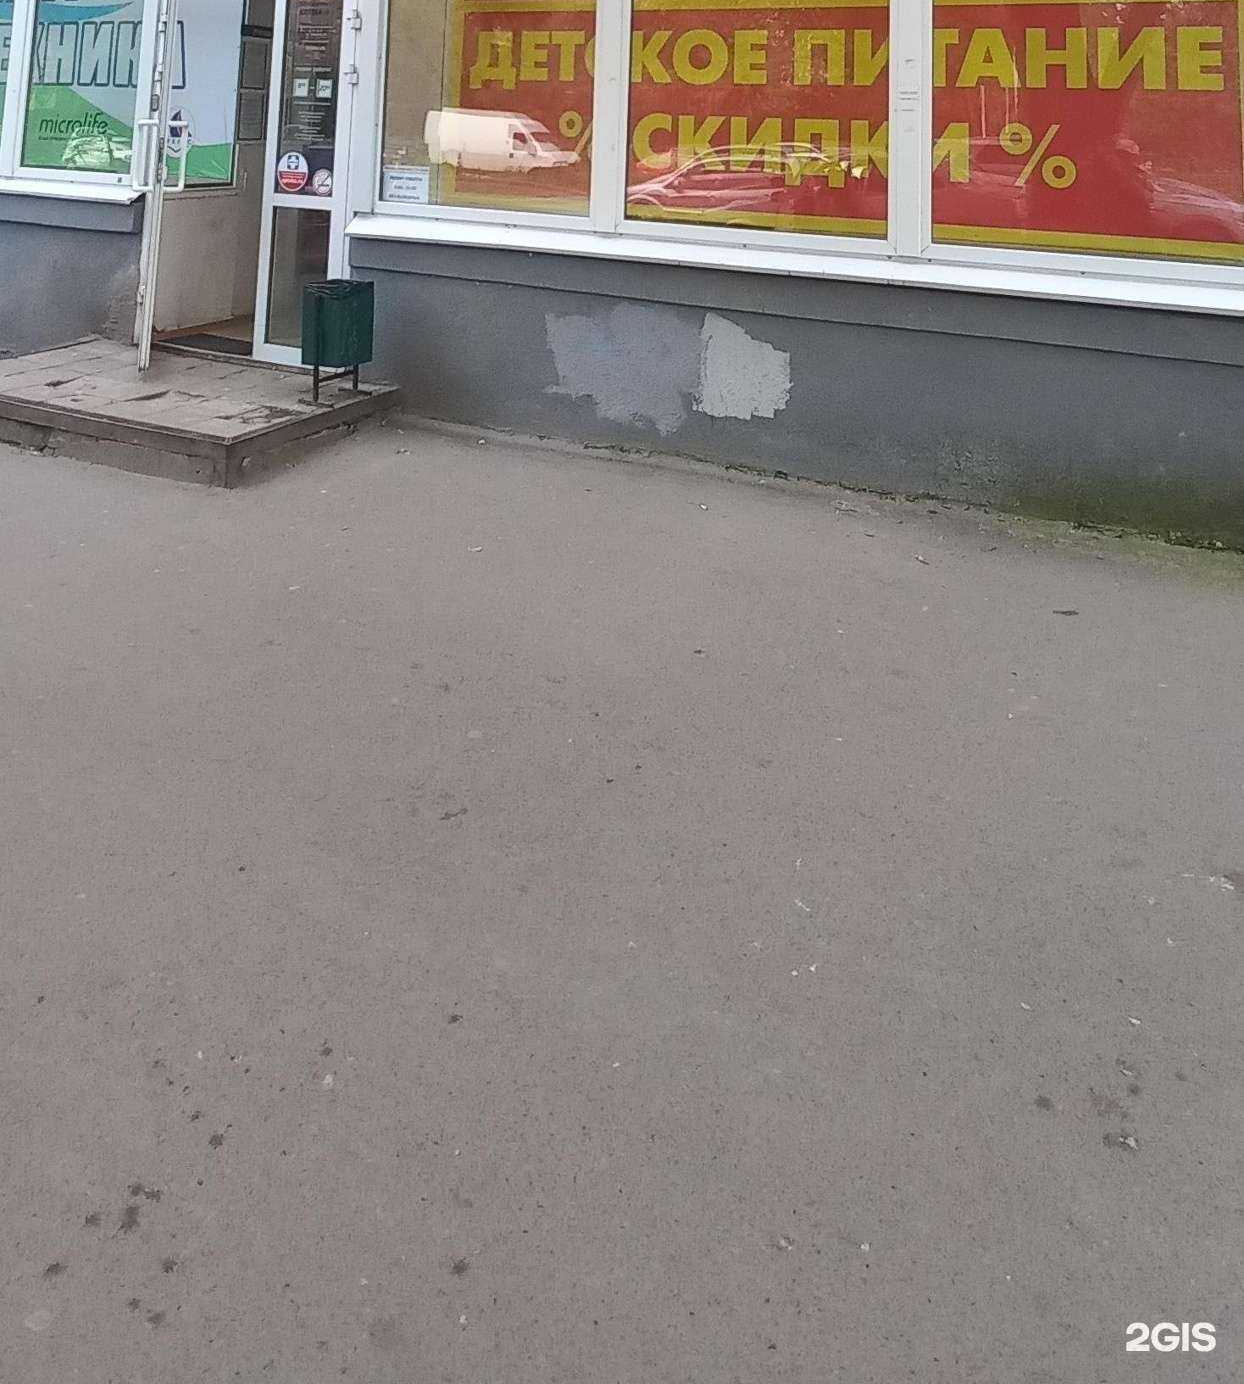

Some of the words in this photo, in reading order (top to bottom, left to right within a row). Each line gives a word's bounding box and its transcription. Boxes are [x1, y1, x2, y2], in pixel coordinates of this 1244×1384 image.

[469, 29, 769, 90] ДЕТКОЕ
[39, 112, 109, 135] microlife
[999, 122, 1078, 189] %
